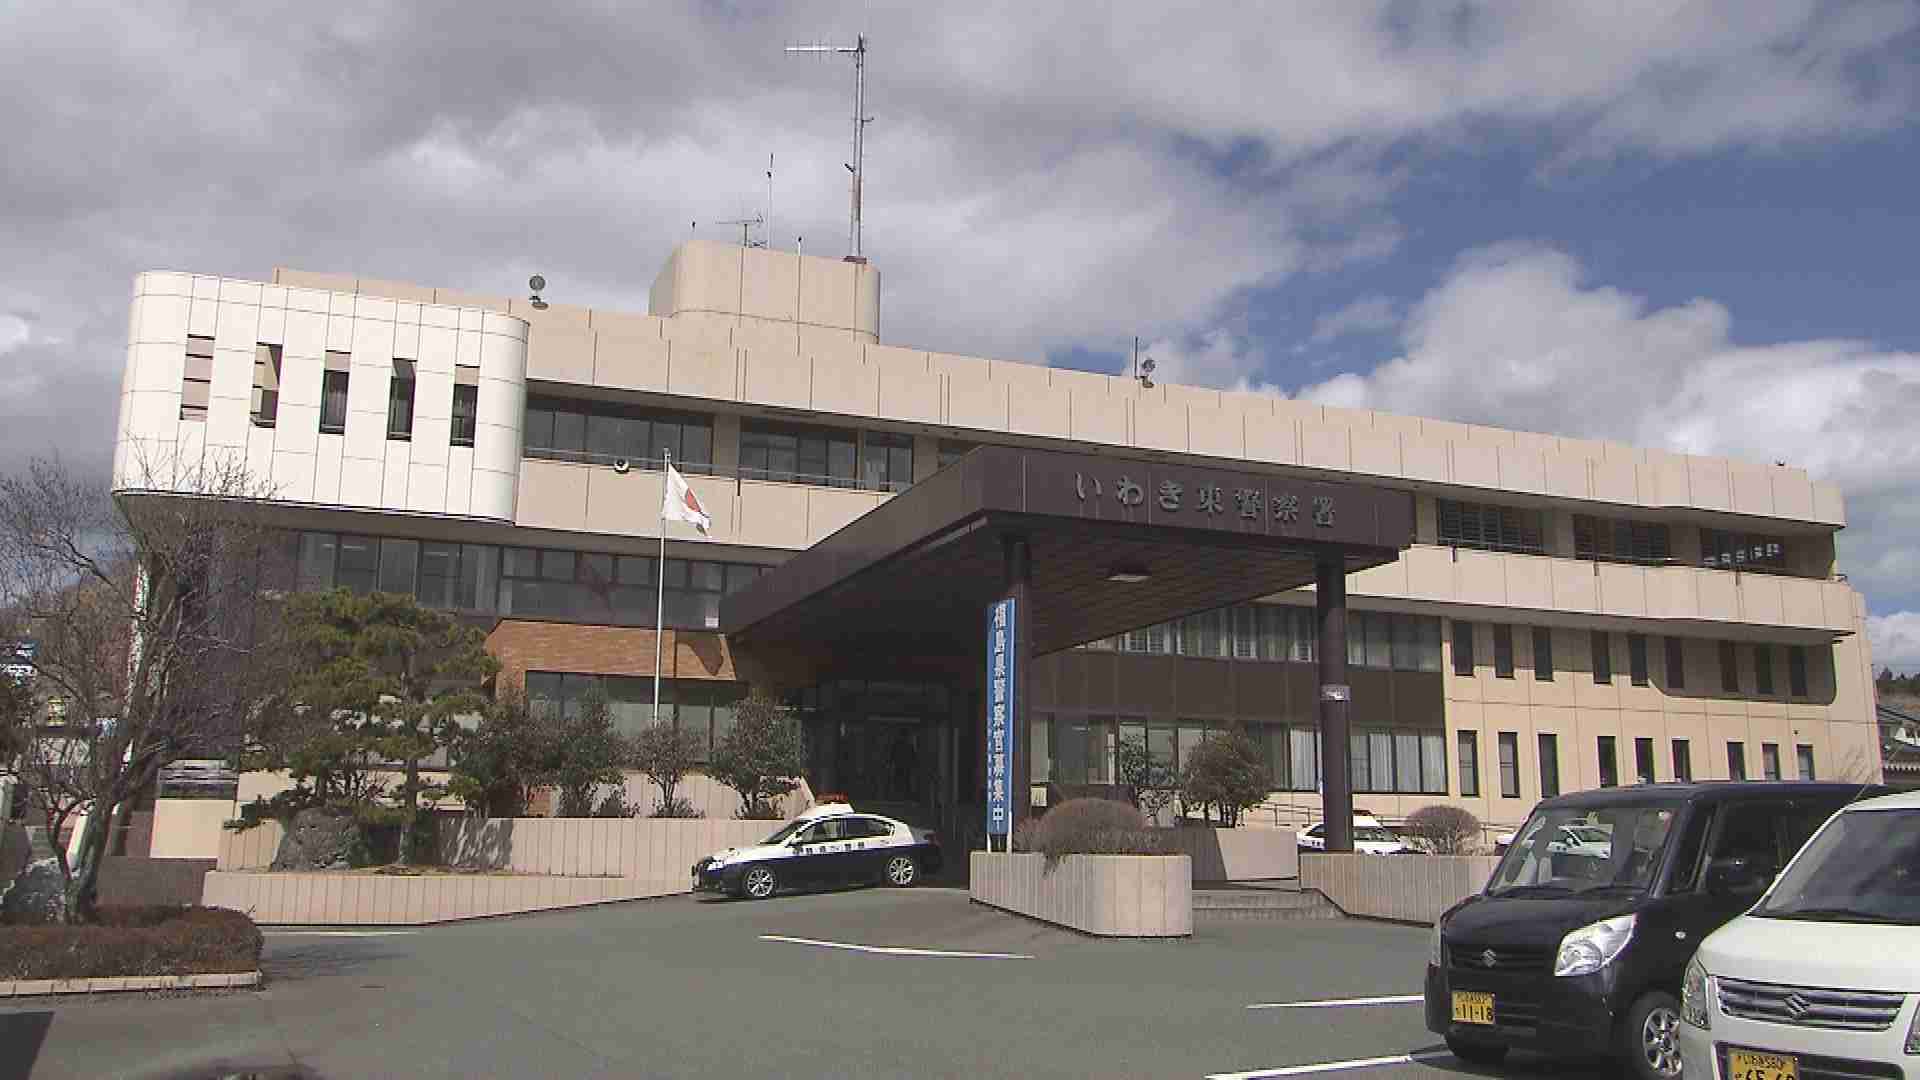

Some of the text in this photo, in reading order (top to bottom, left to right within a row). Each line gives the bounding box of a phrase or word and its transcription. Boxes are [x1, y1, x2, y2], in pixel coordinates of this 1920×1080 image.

[1075, 471, 1336, 528] いわき東警察署
